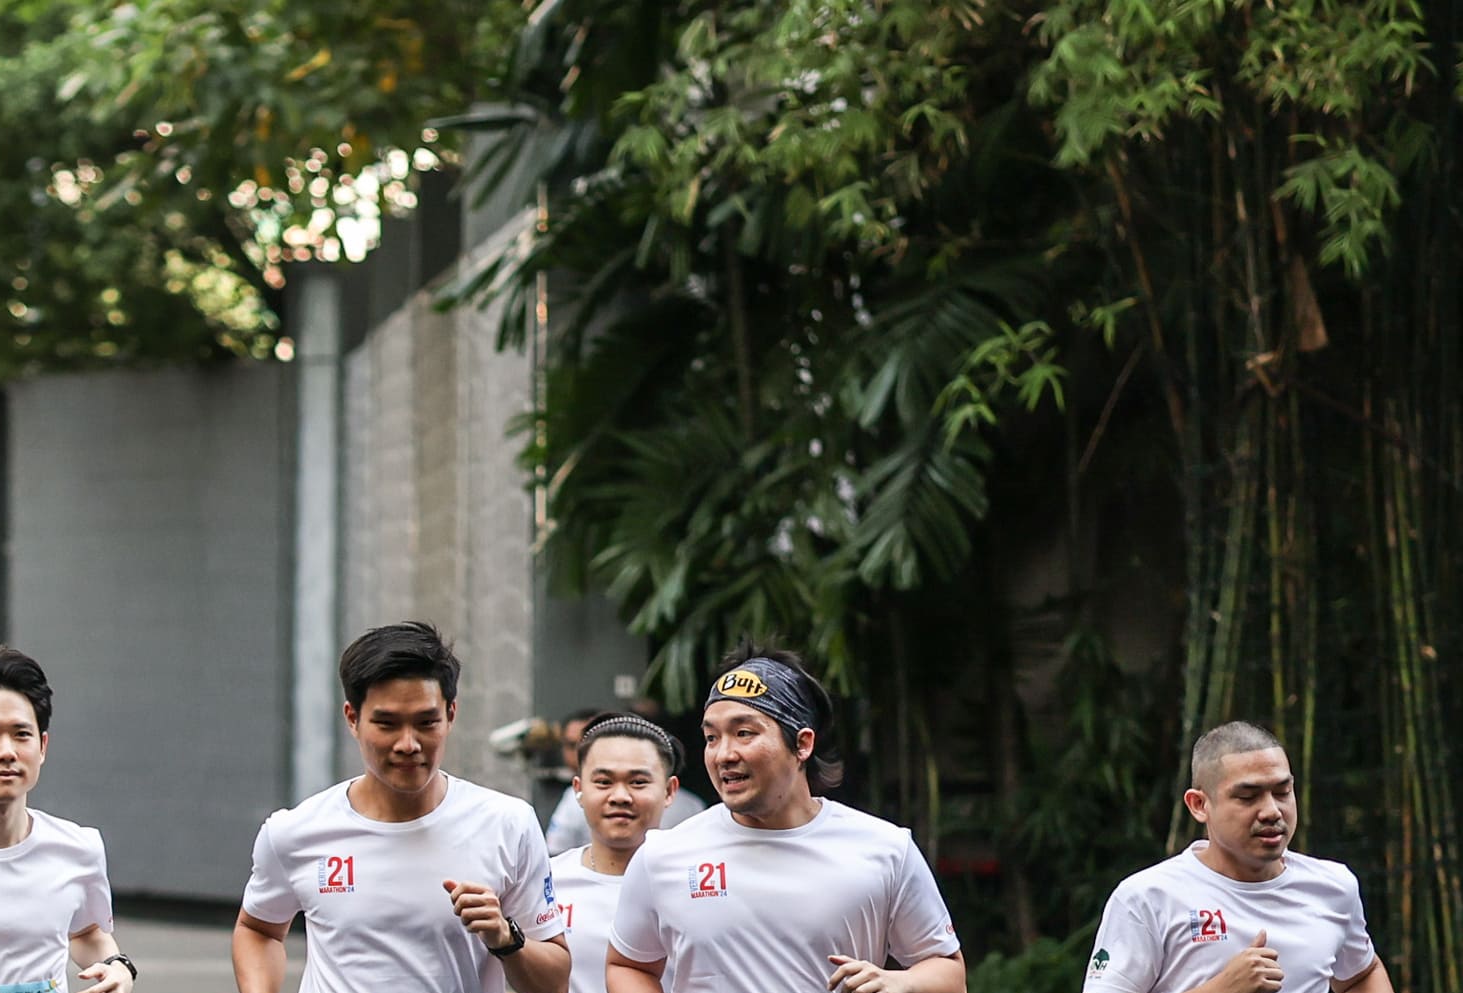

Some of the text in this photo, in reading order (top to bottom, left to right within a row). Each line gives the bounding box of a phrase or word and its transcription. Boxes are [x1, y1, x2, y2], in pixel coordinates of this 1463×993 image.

[327, 855, 354, 886] 21
[699, 862, 726, 891] 21
[557, 904, 573, 928] 1
[1199, 909, 1226, 936] 21
